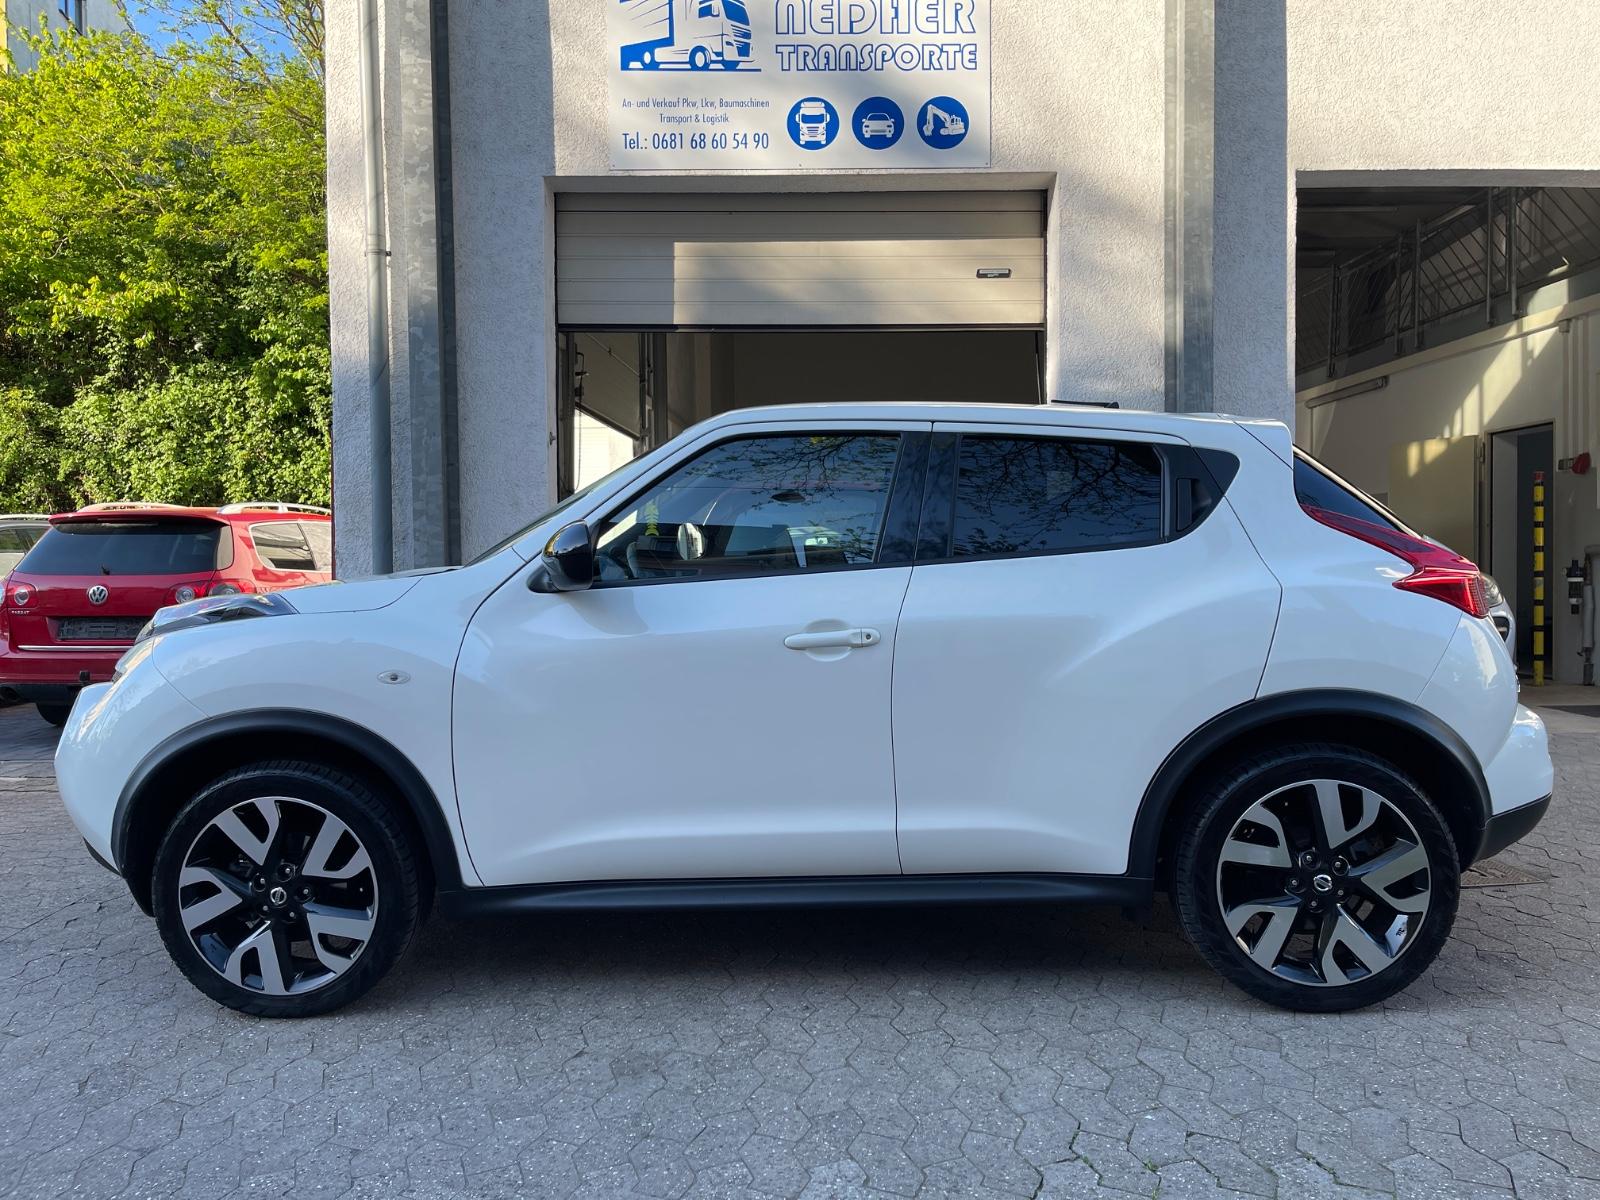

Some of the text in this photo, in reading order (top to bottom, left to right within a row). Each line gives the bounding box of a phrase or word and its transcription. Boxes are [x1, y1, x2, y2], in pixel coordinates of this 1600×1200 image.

[776, 43, 977, 71] TRANSPORTE
[622, 98, 770, 109] An- und Verkauf Pkw, Lkw, Baumaschinen
[659, 113, 729, 125] Transport & Logistik
[622, 132, 769, 150] Tel.: 0681 68 60 54 90
